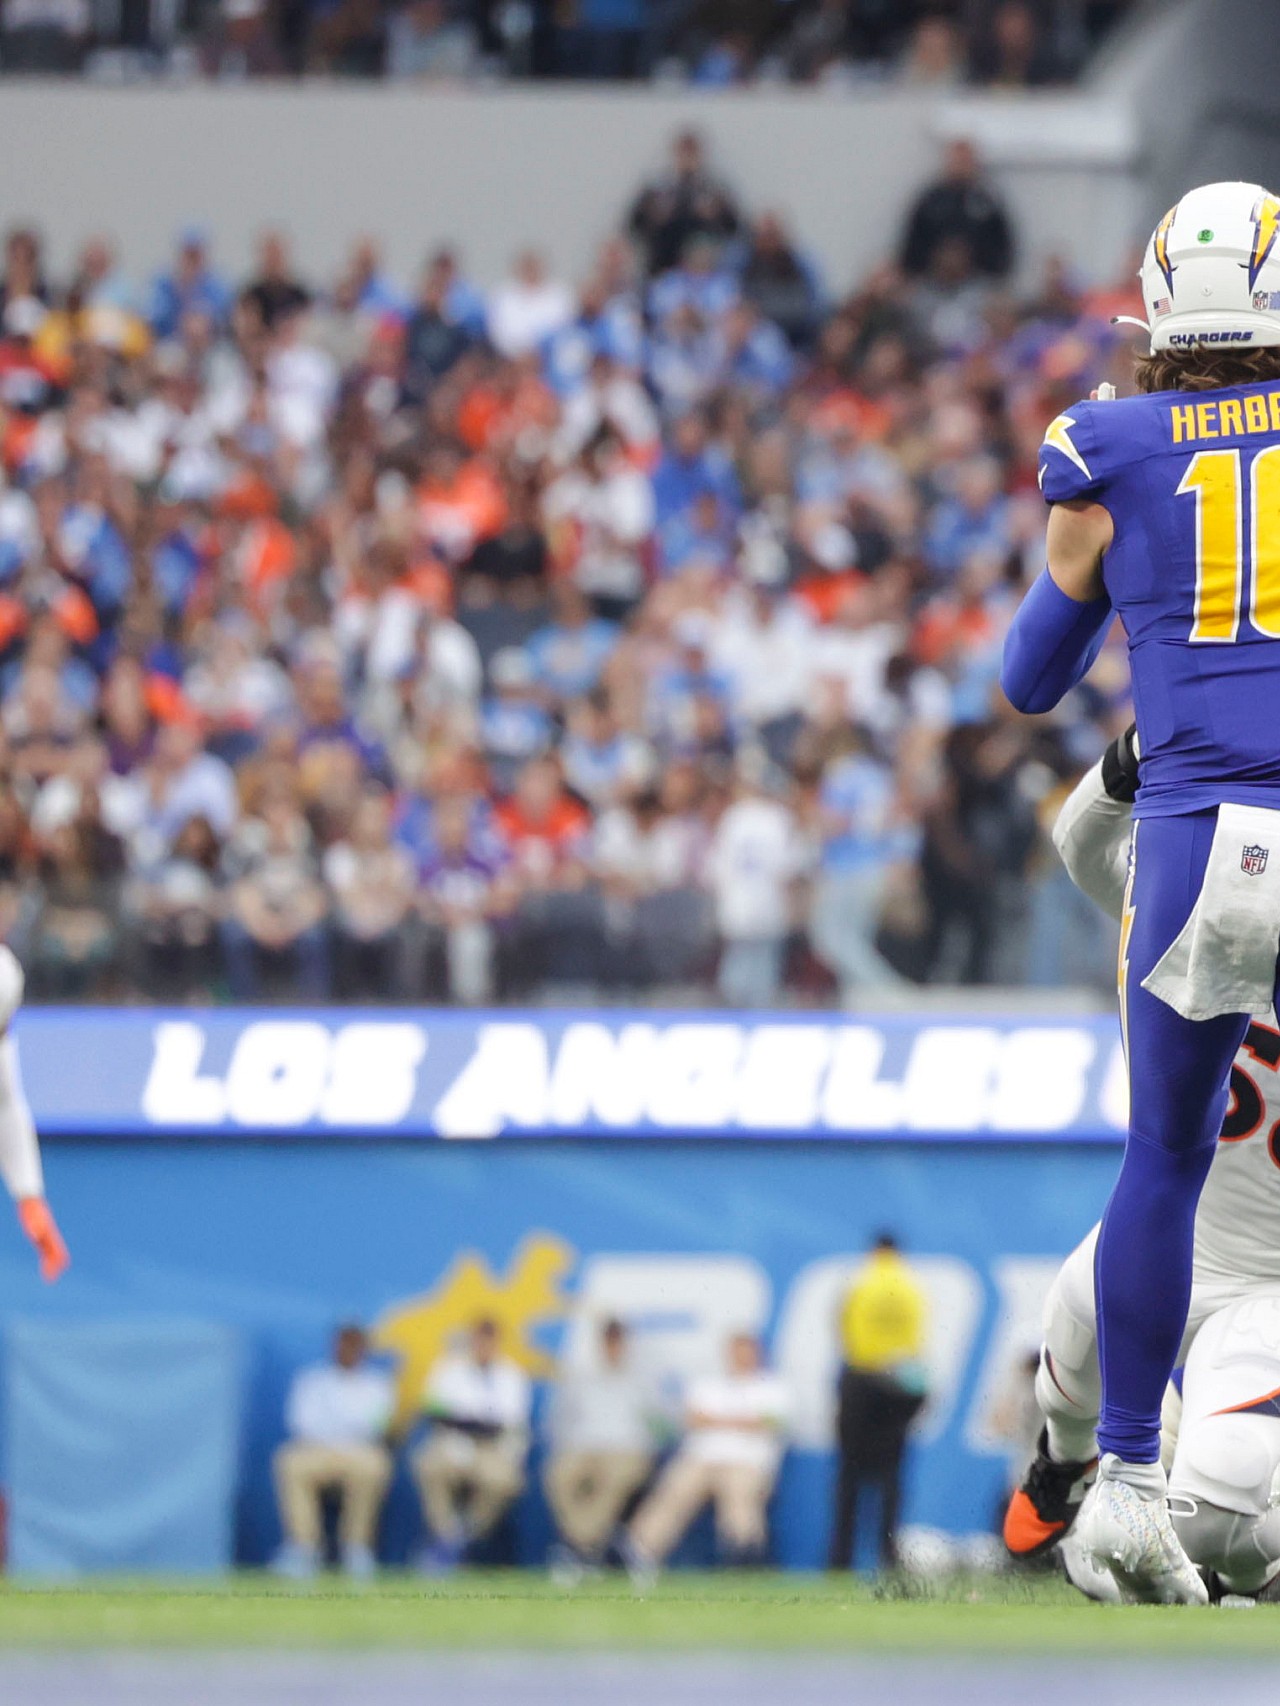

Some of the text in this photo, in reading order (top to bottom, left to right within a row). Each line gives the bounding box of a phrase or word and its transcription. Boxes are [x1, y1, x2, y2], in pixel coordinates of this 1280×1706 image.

[1169, 331, 1254, 348] CHARGERS
[1243, 856, 1266, 872] NFL
[141, 1021, 427, 1126] LOS
[431, 1022, 1097, 1139] ANGELES
